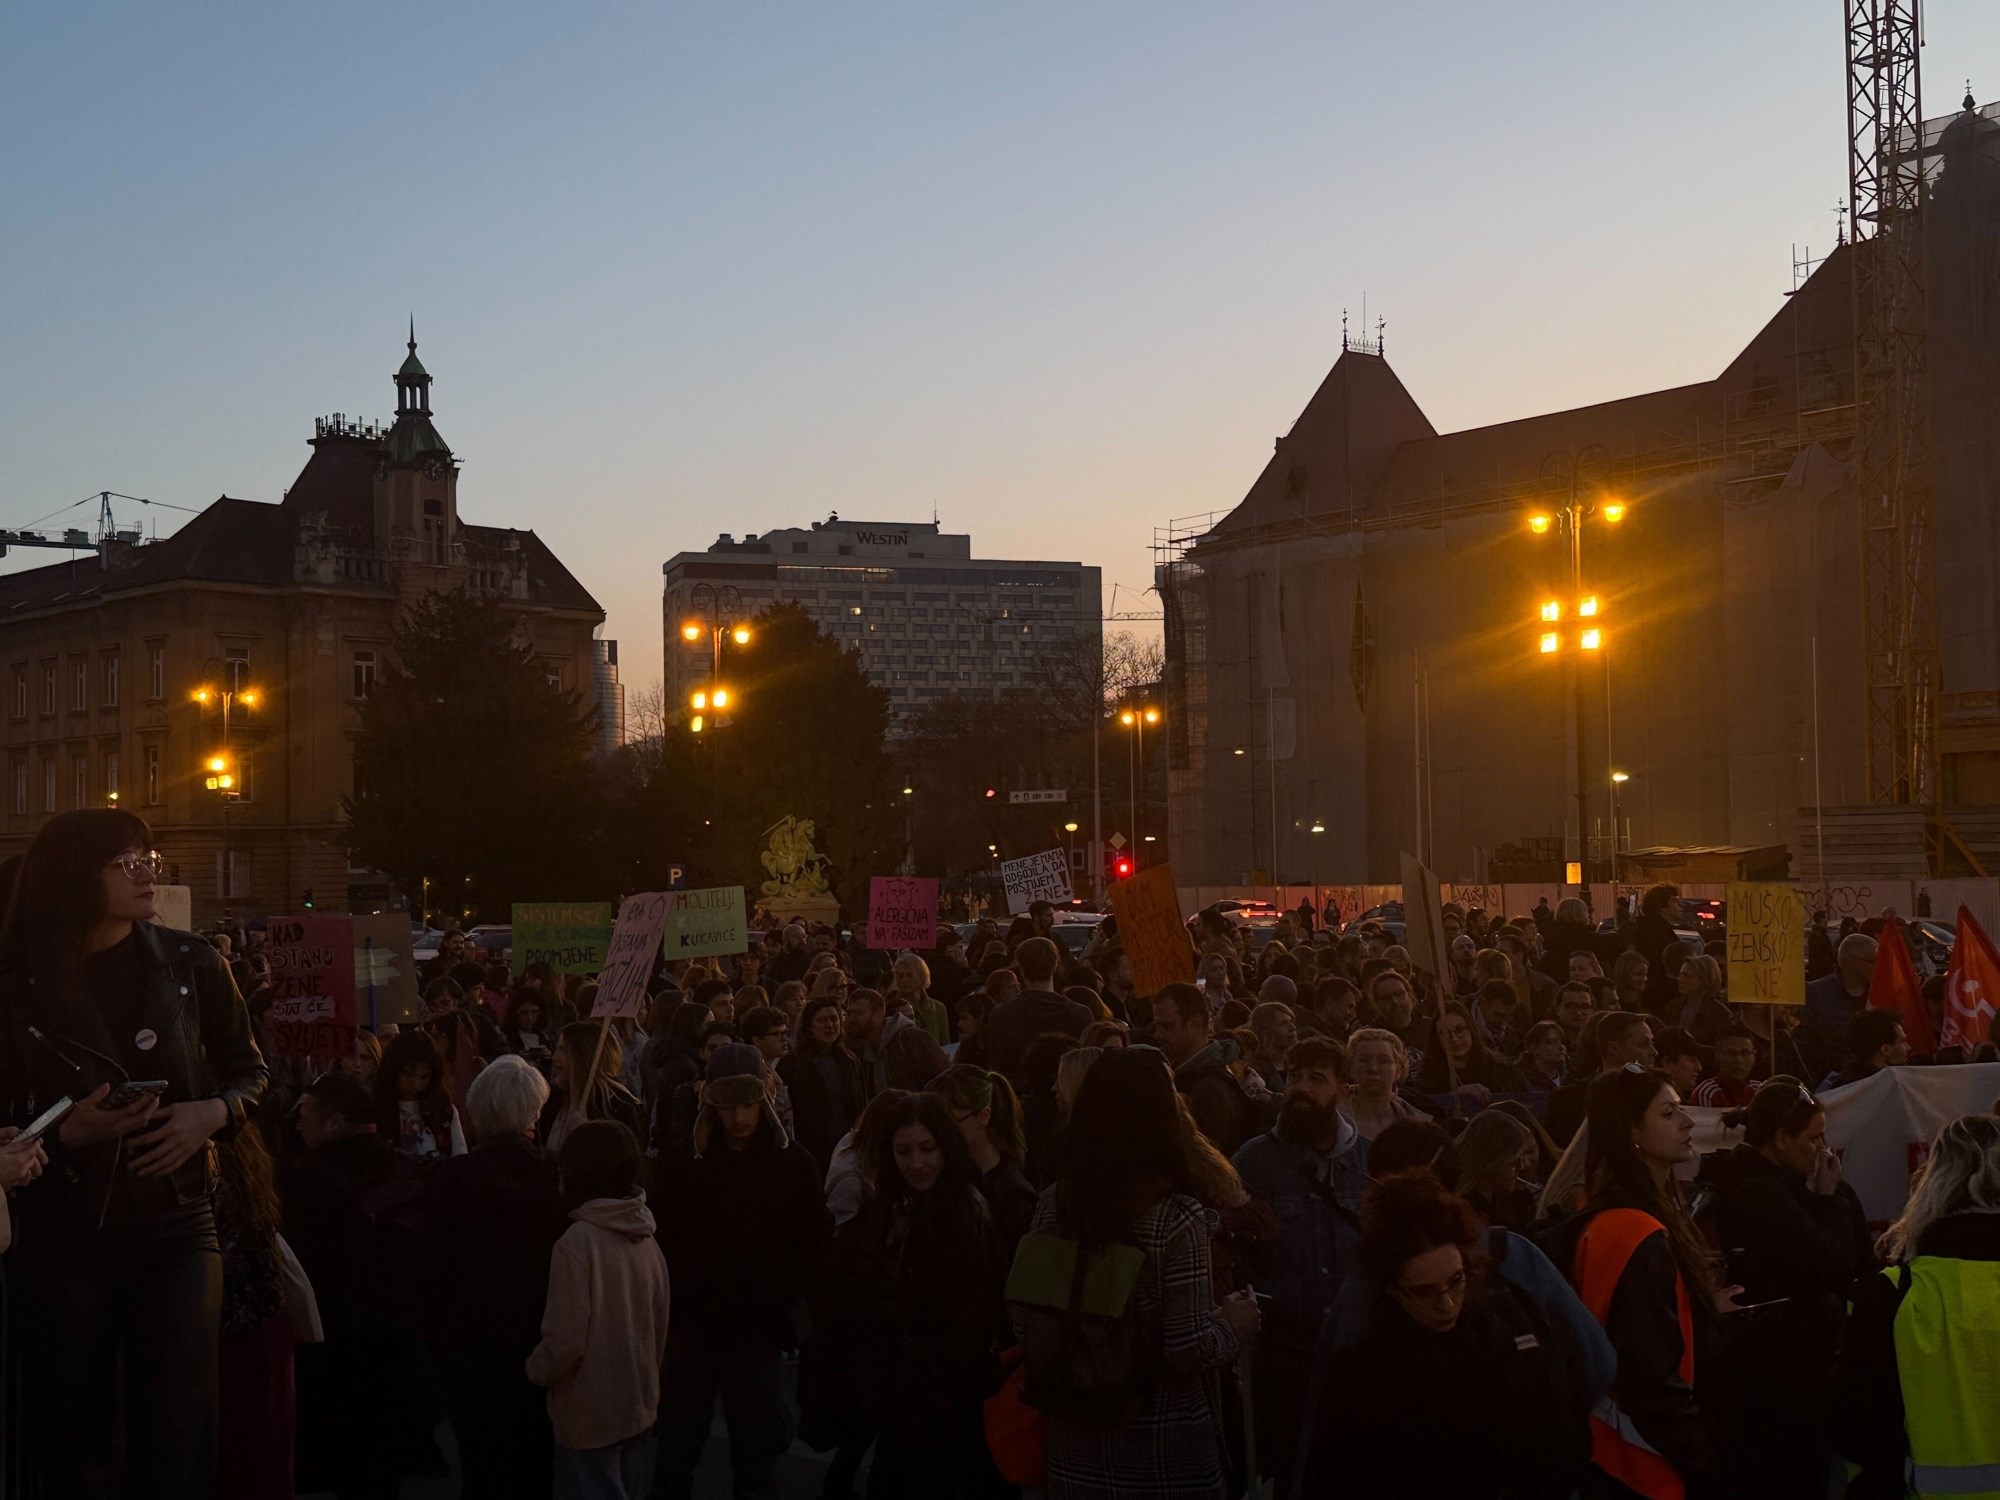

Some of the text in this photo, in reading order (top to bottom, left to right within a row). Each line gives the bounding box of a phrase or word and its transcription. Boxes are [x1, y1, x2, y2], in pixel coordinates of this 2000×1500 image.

[856, 531, 908, 545] WESTIN
[1004, 849, 1065, 873] MENE JE MAMA
[1005, 860, 1066, 883] ODGOJILA DA
[670, 868, 683, 885] P
[676, 888, 735, 911] MOLITELJI
[1732, 889, 1791, 930] MUŠKO
[272, 922, 304, 946] KAD
[680, 928, 737, 947] KUKAVICE
[874, 924, 929, 941] NA FAŠIZAM
[525, 946, 599, 967] PROMJENE
